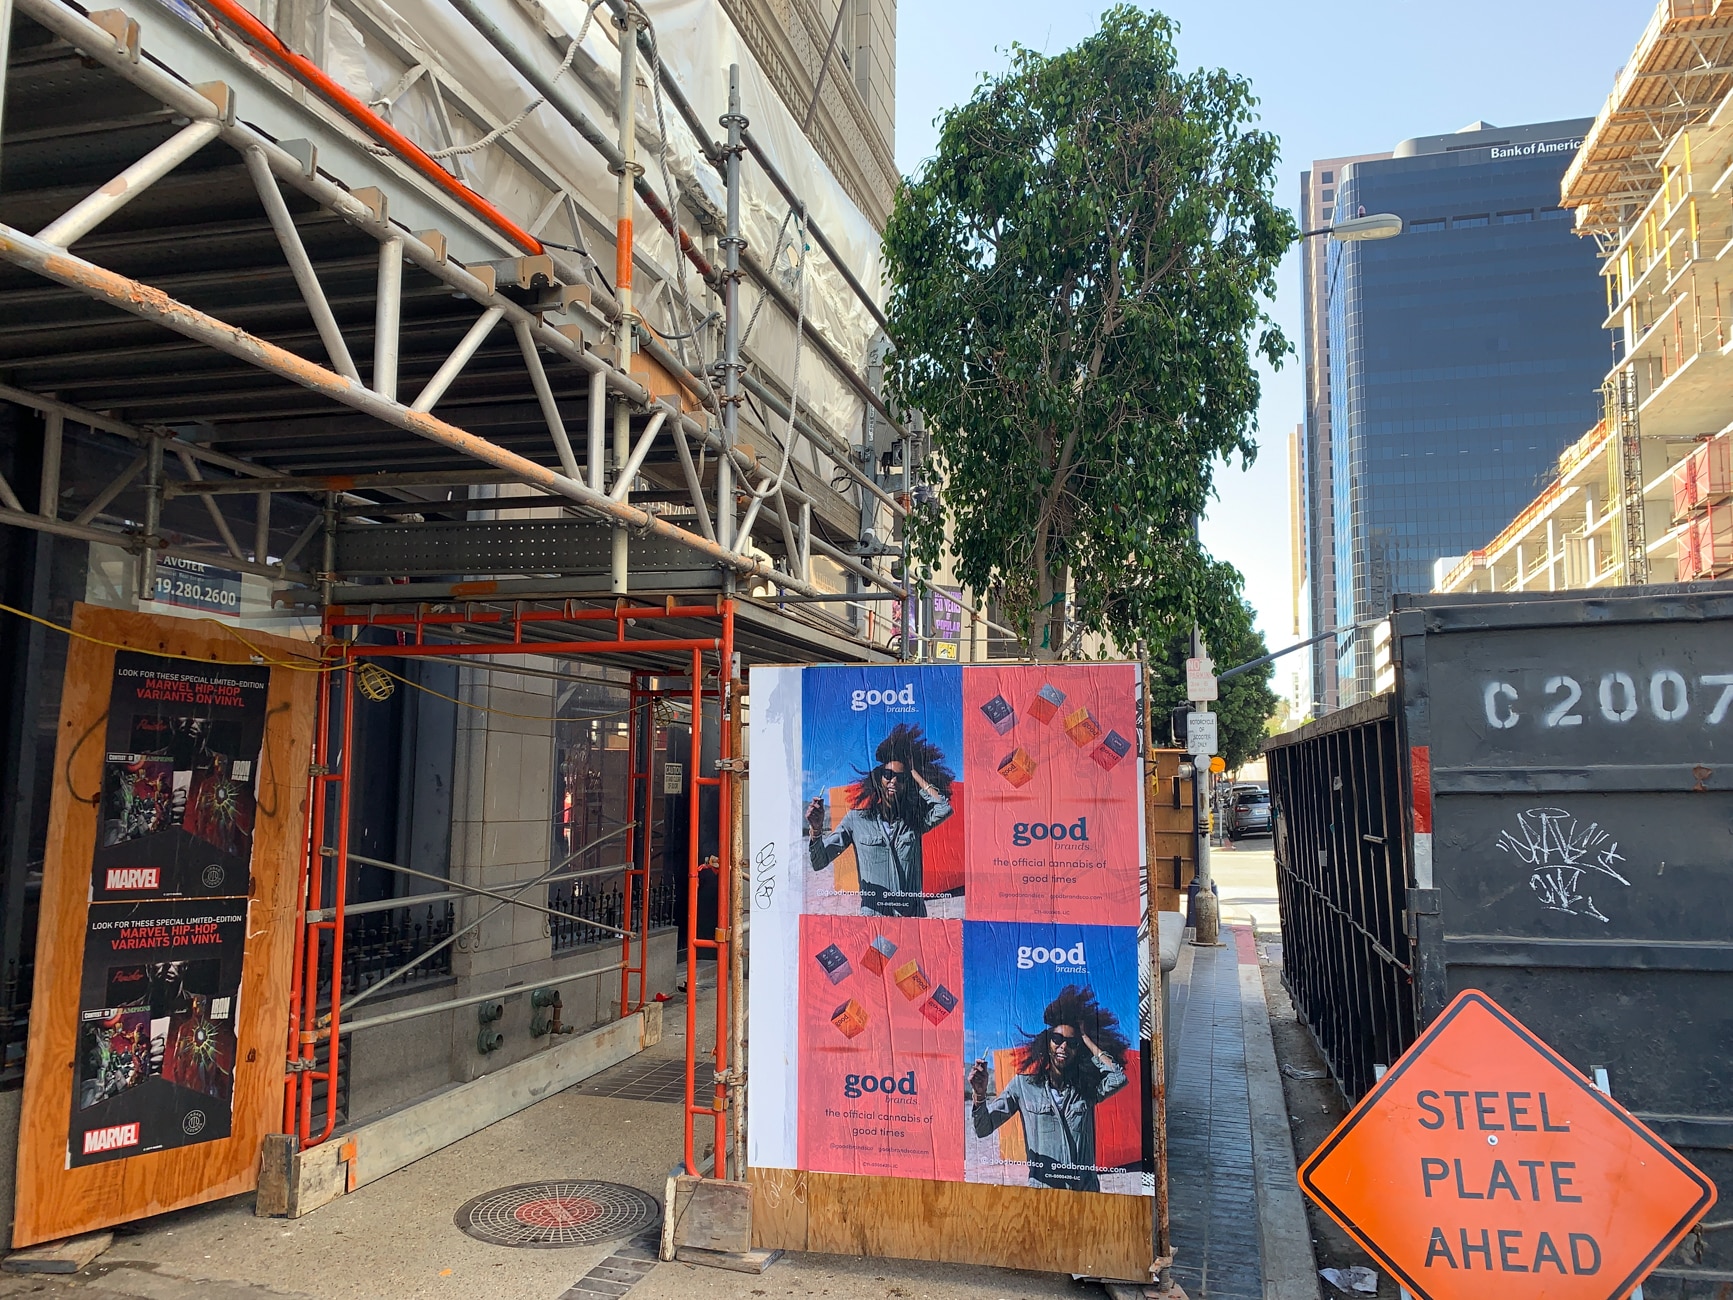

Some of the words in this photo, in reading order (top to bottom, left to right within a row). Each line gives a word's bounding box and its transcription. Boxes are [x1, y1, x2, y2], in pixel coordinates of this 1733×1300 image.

[1491, 145, 1521, 158] Bank
[1523, 142, 1536, 154] of
[155, 577, 236, 606] 19.280.2600
[1188, 659, 1200, 671] NO
[118, 668, 138, 677] LOOK
[140, 670, 154, 678] FOR
[156, 672, 180, 681] THESE
[180, 674, 208, 684] SPECIAL
[210, 678, 264, 689] LIMITED-EDITION
[146, 679, 192, 693] MARVEL
[195, 683, 240, 696] HIP-HOP
[136, 688, 194, 703] VARIANTS
[196, 694, 212, 704] ON
[214, 696, 245, 707] VINYL
[850, 683, 916, 712] good
[1484, 681, 1520, 728] C
[1545, 670, 1733, 727] 2007
[1012, 816, 1089, 846] good
[994, 858, 1009, 866] the
[1012, 858, 1046, 868] official
[1049, 859, 1094, 868] cannabis
[1096, 860, 1106, 869] of
[106, 868, 158, 889] MARVEL
[1022, 874, 1048, 884] good
[1051, 874, 1077, 884] times
[882, 890, 952, 899] goodbrandsco.com
[92, 922, 112, 930] LOOK
[131, 920, 154, 928] THESE
[156, 918, 184, 926] SPECIAL
[186, 915, 242, 925] LIMITED-EDITION
[120, 926, 168, 939] MARVEL
[172, 924, 218, 936] HIP-HOP
[111, 937, 170, 950] VARIANTS
[172, 936, 190, 946] ON
[191, 933, 222, 944] VINYL
[1017, 942, 1086, 970] good
[844, 1070, 918, 1098] good
[825, 1108, 840, 1118] the
[844, 1110, 874, 1120] official
[878, 1112, 921, 1123] cannabis
[924, 1115, 934, 1124] of
[1416, 1090, 1570, 1132] STEEL
[84, 1124, 138, 1153] MARVEL
[852, 1128, 877, 1136] good
[880, 1128, 905, 1138] times
[1050, 1162, 1126, 1174] goodbrandsco.com
[1420, 1157, 1583, 1204] PLATE
[1424, 1226, 1602, 1276] AHEAD
